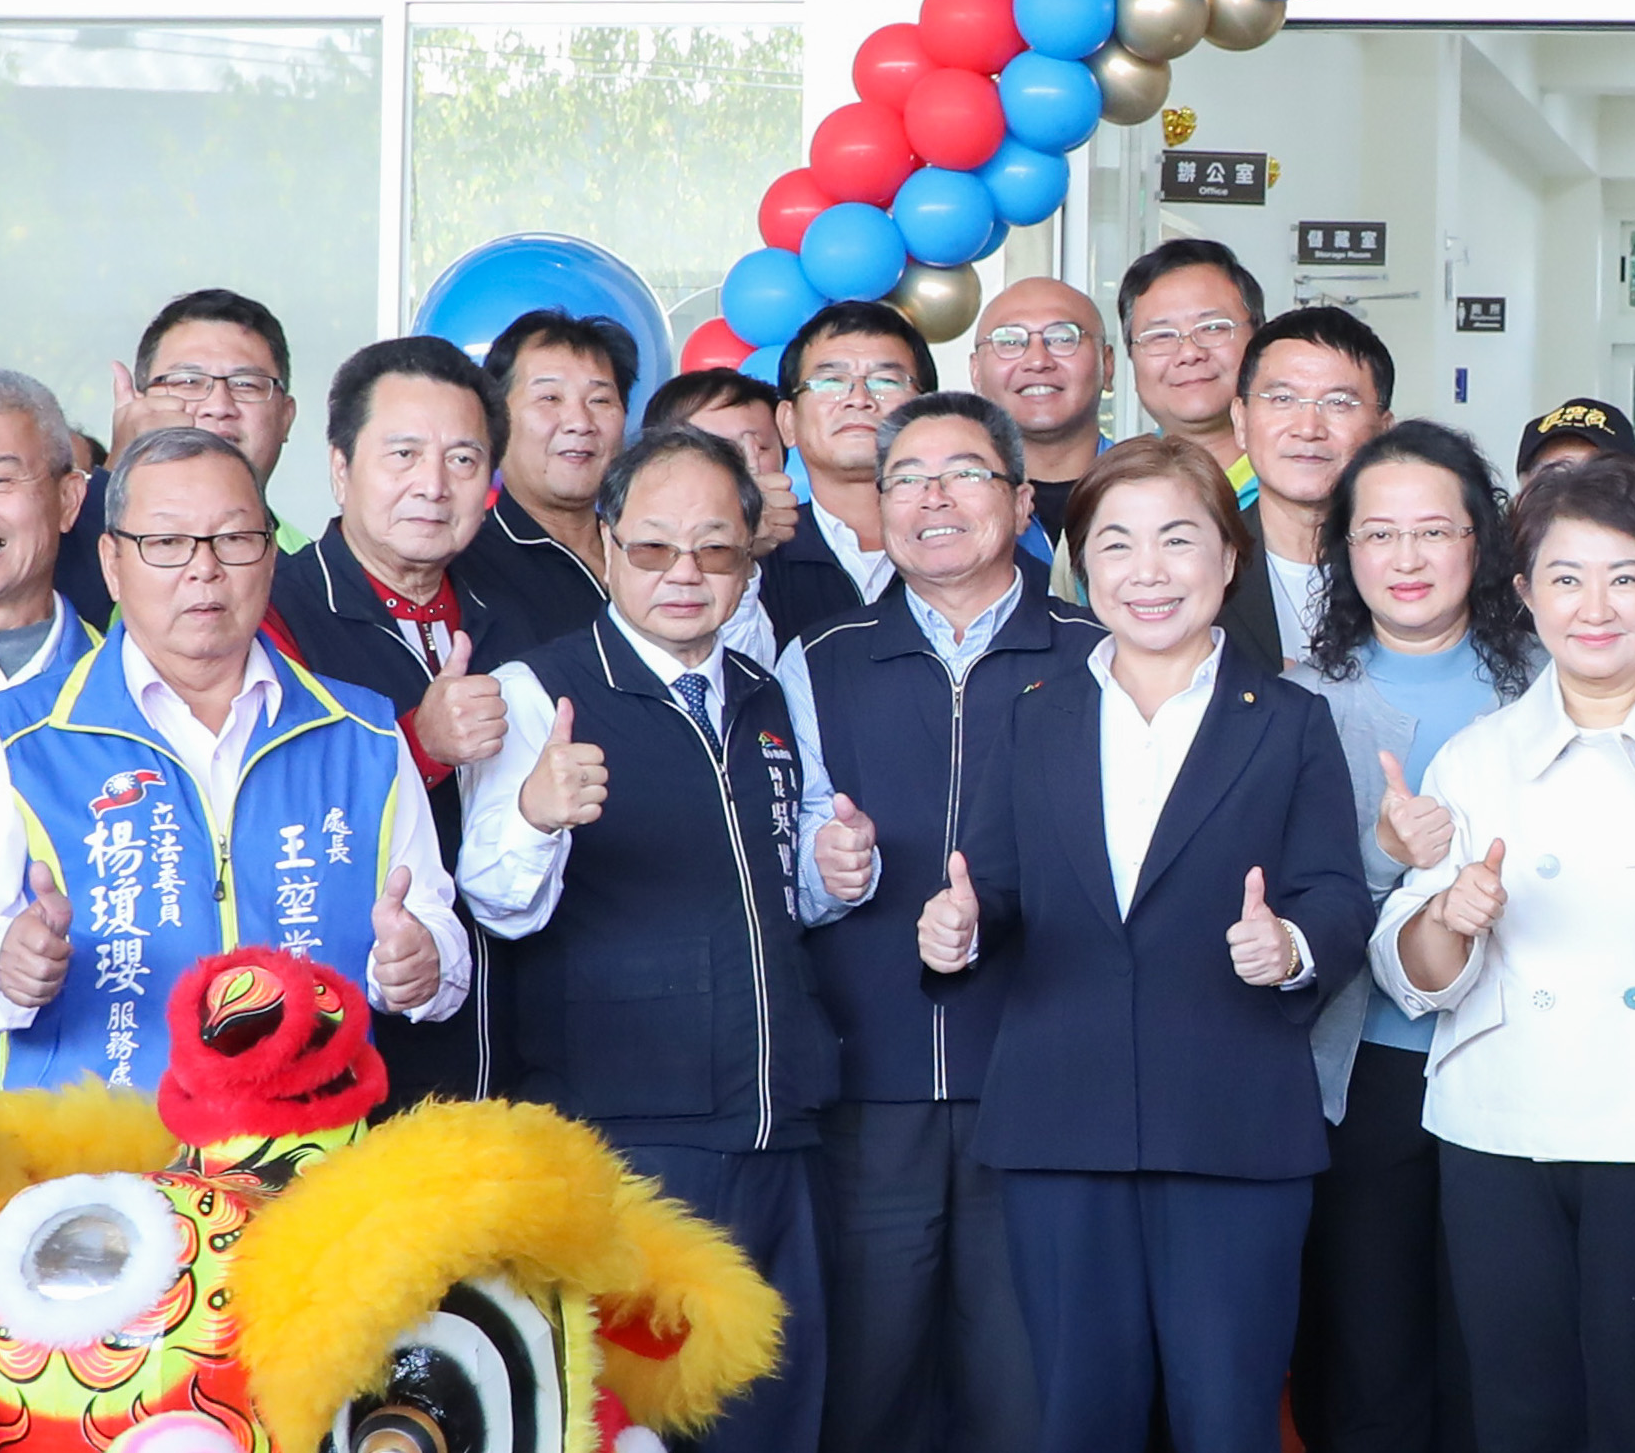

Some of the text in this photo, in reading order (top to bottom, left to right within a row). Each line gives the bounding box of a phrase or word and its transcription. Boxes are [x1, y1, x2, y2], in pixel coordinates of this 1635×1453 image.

[1177, 160, 1255, 185] 辦公室
[1198, 185, 1229, 197] Office
[148, 801, 187, 929] 立法委員
[321, 806, 354, 865] 處長
[82, 819, 152, 997] 楊瓊瓔
